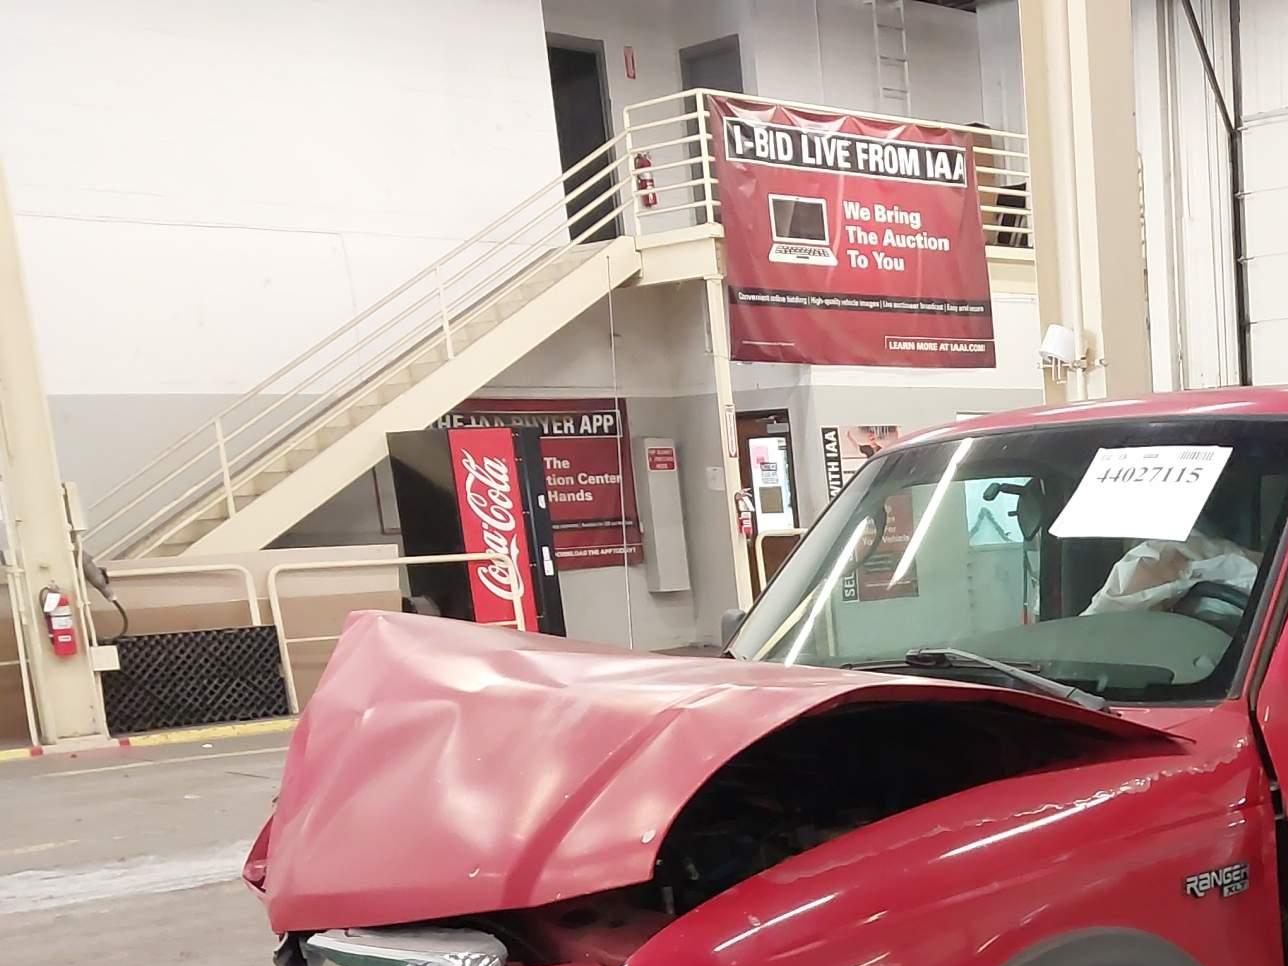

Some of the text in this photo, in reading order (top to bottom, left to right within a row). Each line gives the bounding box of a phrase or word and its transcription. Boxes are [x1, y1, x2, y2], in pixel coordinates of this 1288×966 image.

[734, 124, 964, 181] I-BID LIVE FROM IAA
[843, 200, 921, 229] We Bring
[845, 225, 950, 251] The Auction
[847, 249, 905, 271] To You
[889, 341, 915, 350] LEARN
[917, 342, 938, 351] MORE
[939, 342, 950, 351] AT
[430, 414, 464, 429] HE
[580, 414, 614, 434] APP
[825, 431, 839, 457] IAA
[543, 457, 570, 470] The
[577, 472, 621, 485] Center
[1096, 466, 1203, 484] 44027115
[547, 489, 593, 503] Hands
[461, 449, 524, 600] Coca-Cola
